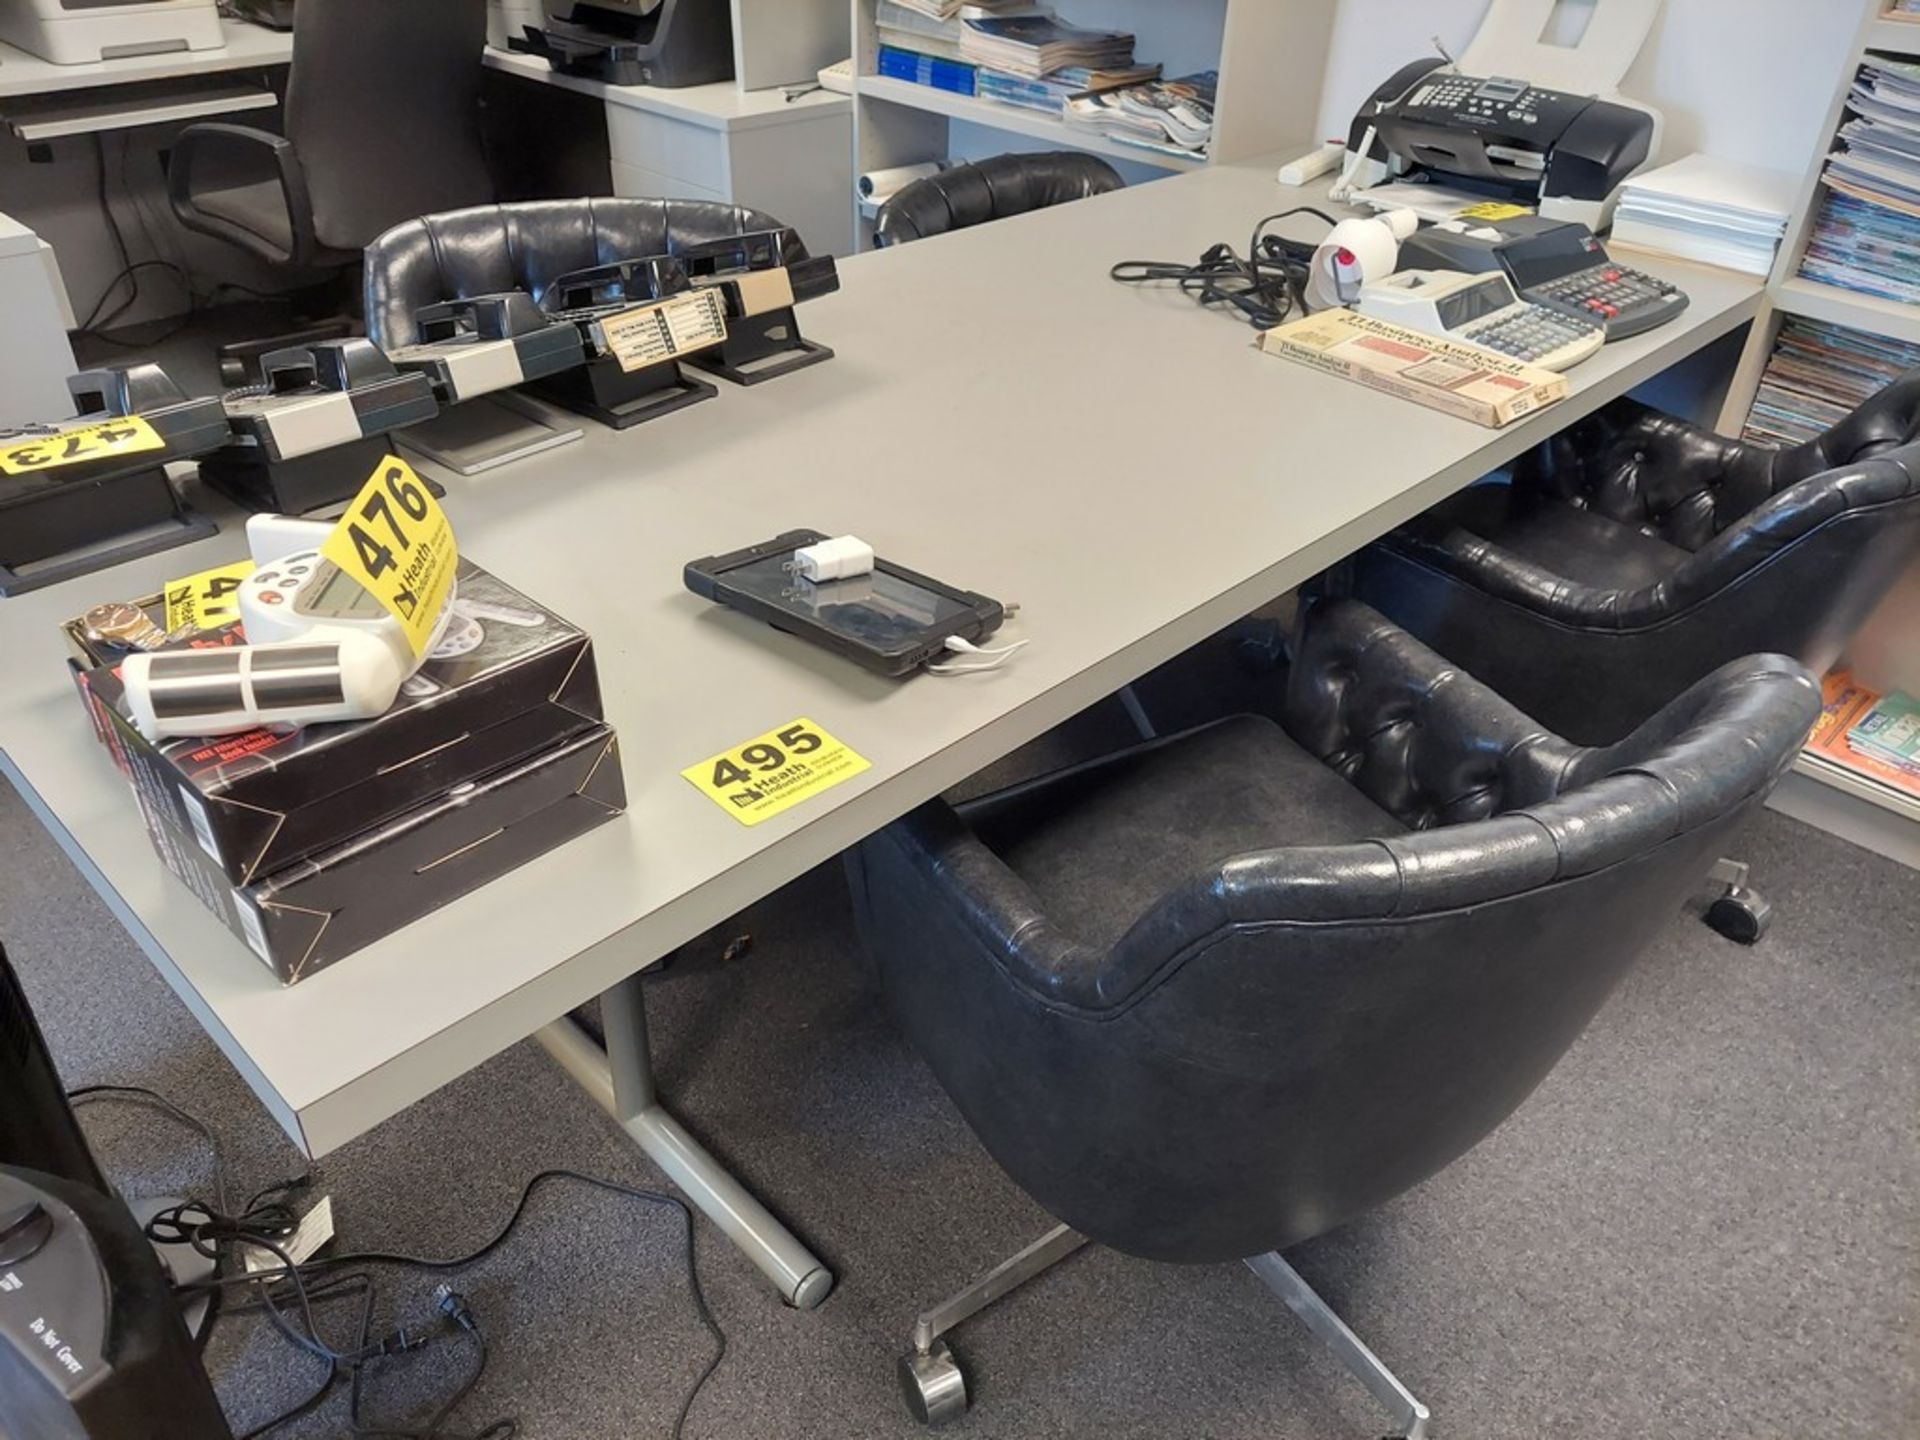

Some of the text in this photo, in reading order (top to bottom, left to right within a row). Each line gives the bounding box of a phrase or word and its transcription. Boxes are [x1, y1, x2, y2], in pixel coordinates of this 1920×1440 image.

[1367, 320, 1433, 346] Business
[7, 426, 138, 467] 473
[347, 466, 428, 580] 476
[402, 541, 431, 588] Heath
[712, 724, 822, 789] 495
[753, 762, 808, 790] Heath
[763, 769, 814, 797] Industrial
[29, 1317, 84, 1374] Do Not Cover
